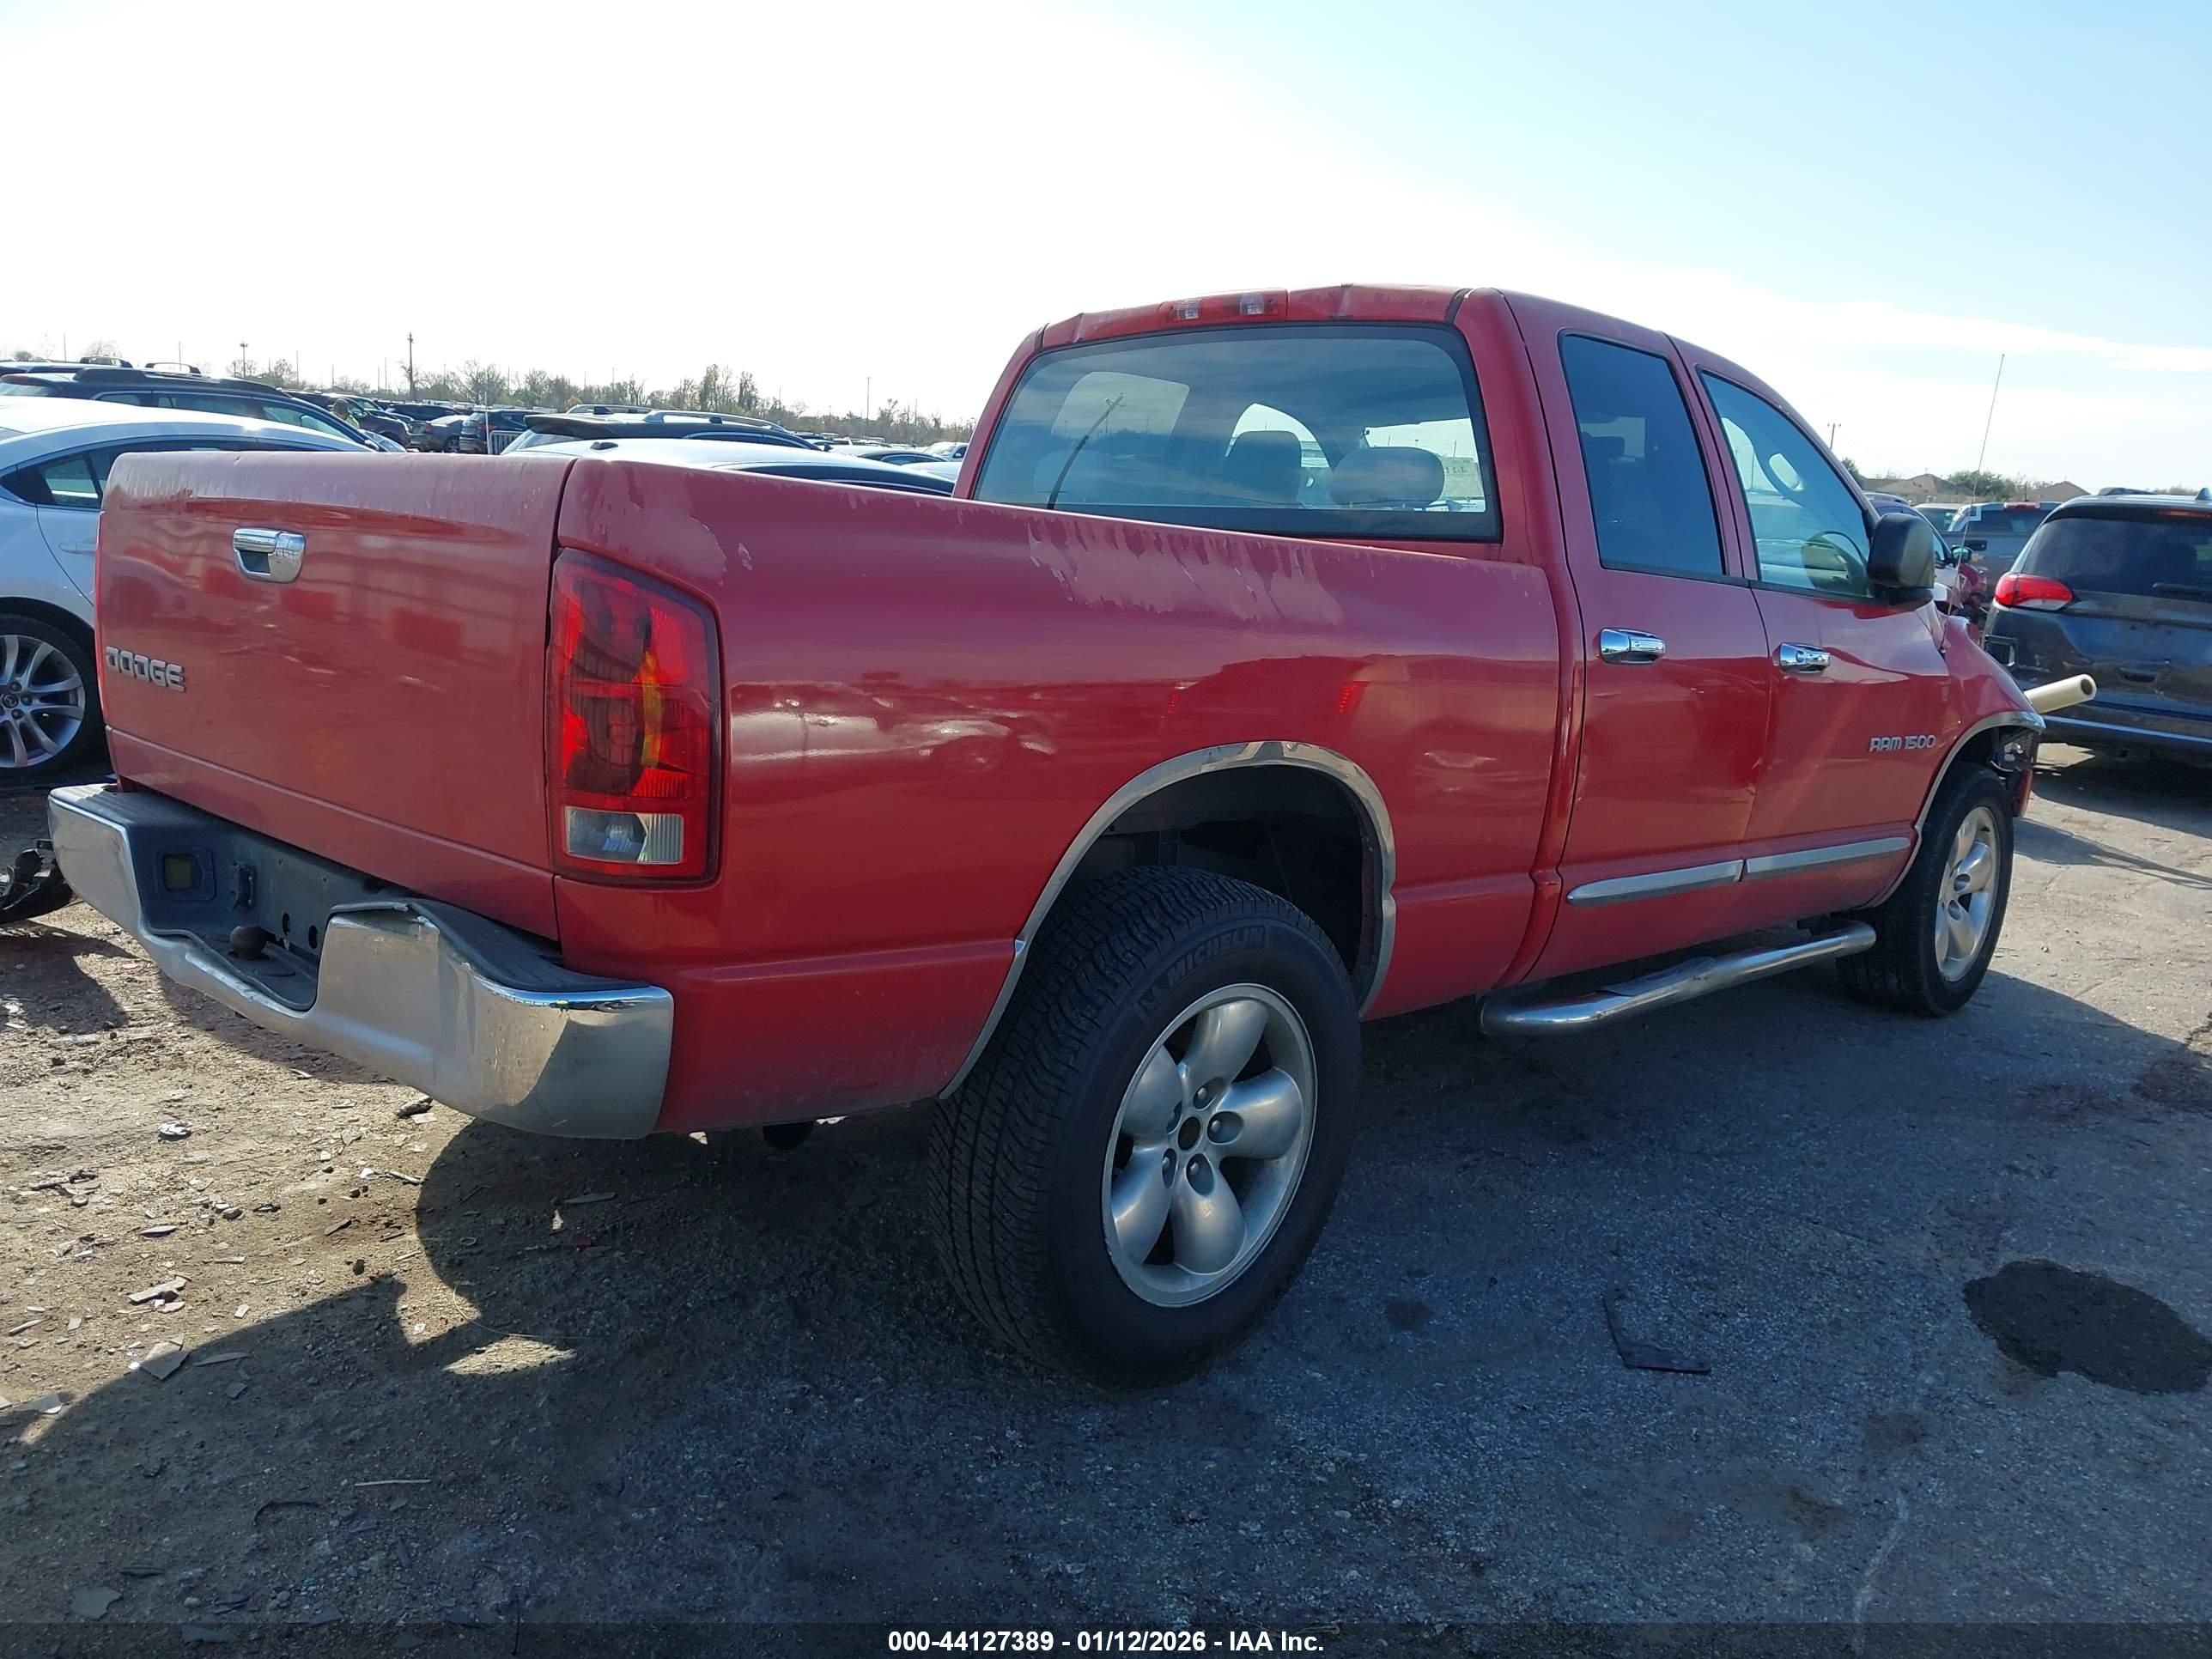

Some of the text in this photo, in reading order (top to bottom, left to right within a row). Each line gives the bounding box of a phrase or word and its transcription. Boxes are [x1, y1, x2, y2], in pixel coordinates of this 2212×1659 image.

[106, 646, 185, 693] DODGE
[1869, 734, 1936, 752] RAM 1500
[1167, 925, 1267, 984] MICHELIN
